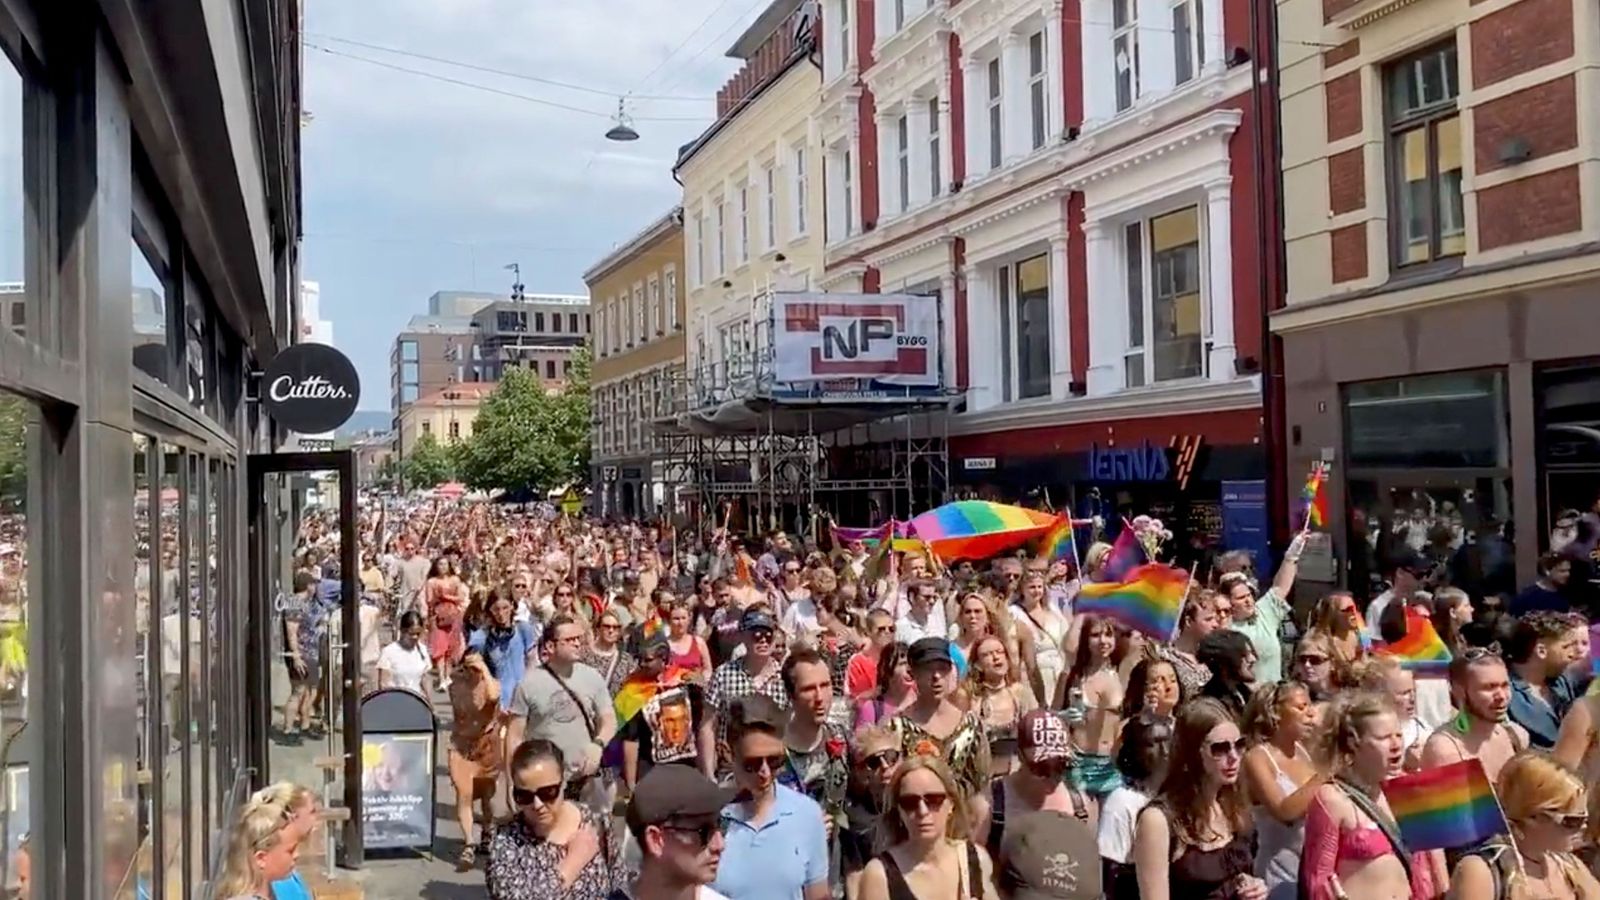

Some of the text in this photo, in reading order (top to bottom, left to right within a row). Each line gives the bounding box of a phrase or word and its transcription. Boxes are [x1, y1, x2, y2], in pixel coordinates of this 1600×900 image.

[823, 319, 893, 359] NP
[897, 336, 927, 346] BYGG
[270, 375, 352, 402] Cutters.
